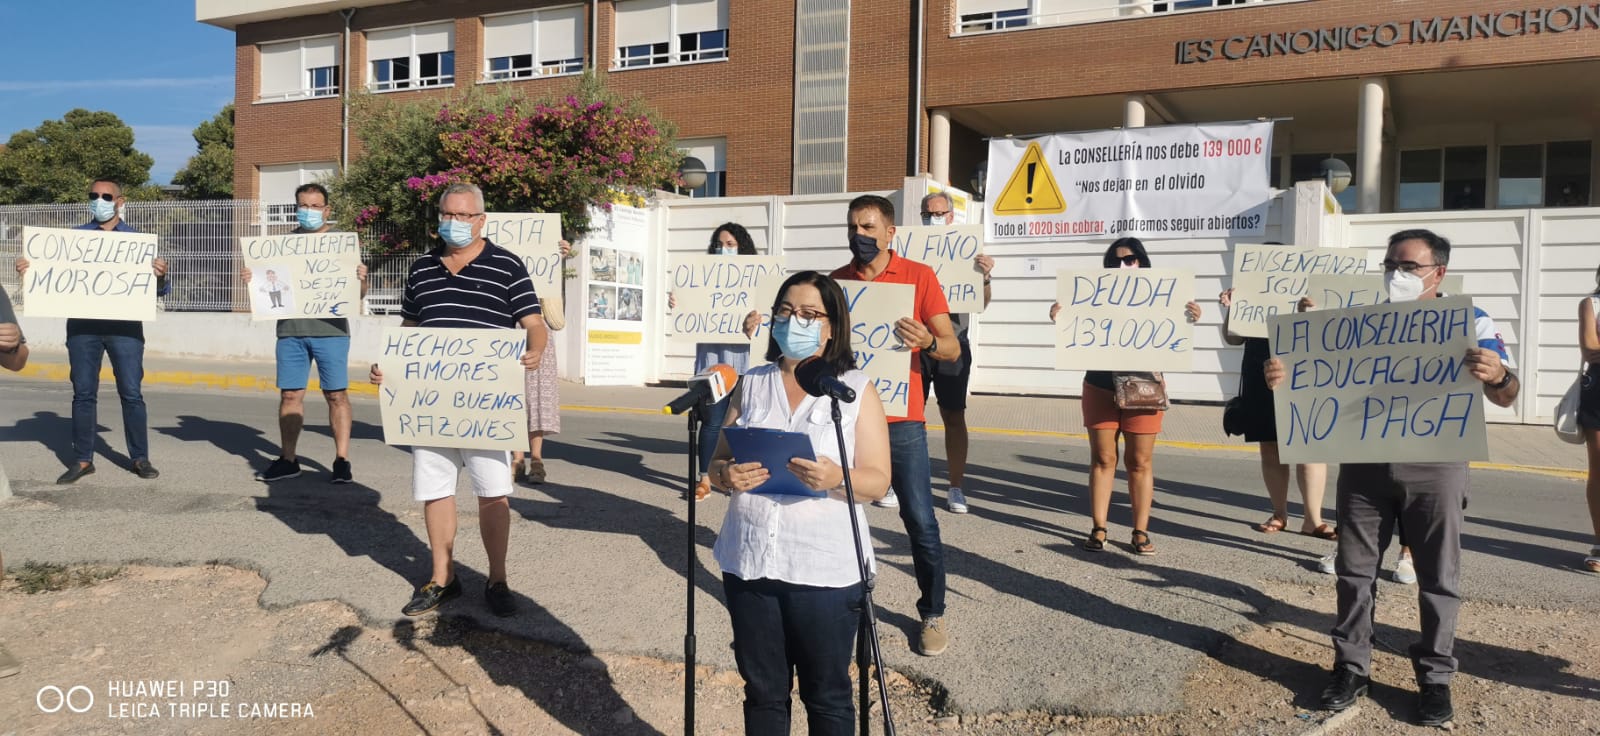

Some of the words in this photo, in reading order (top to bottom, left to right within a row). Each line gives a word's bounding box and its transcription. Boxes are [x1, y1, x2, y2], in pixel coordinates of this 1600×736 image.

[1175, 39, 1215, 64] IES
[1221, 21, 1401, 60] CANONIGO
[1059, 150, 1071, 165] La
[1074, 141, 1142, 165] CONSELLERÍA
[1146, 146, 1167, 161] nos
[1170, 142, 1199, 159] debe
[1203, 140, 1223, 157] 139
[1227, 138, 1251, 156] 000
[1254, 137, 1262, 154] €
[1103, 177, 1132, 193] dejan
[1135, 179, 1148, 191] en
[1154, 174, 1165, 190] el
[1168, 172, 1205, 190] olvido
[486, 218, 544, 245] ASTA
[994, 222, 1015, 236] Todo
[1018, 222, 1026, 235] el
[1029, 221, 1052, 235] 2020
[1055, 220, 1069, 234] sin
[1110, 217, 1168, 234] ¿podremos
[1170, 215, 1205, 232] seguir
[1207, 213, 1260, 231] abiertos?
[27, 233, 156, 264] CONSELLERIA
[248, 235, 356, 260] CONSELLERIA
[305, 259, 341, 275] NOS
[1240, 250, 1367, 274] ENSEÑANZA
[29, 267, 151, 296] MOROSA
[300, 277, 347, 290] DEJA
[1071, 274, 1176, 307] DEUDA
[313, 291, 341, 300] SIN
[711, 291, 748, 309] POR
[303, 302, 327, 315] UN
[1275, 320, 1309, 355] LA
[1322, 308, 1468, 351] CONSELLERIA
[385, 333, 477, 357] HECHOS
[484, 339, 526, 360] SON
[405, 360, 498, 381] AMORES
[385, 388, 397, 406] Y
[412, 389, 439, 408] NO
[453, 392, 523, 410] BUENAS
[400, 414, 516, 440] RAZONES
[1286, 397, 1339, 446] NO
[1361, 393, 1473, 440] PAGA
